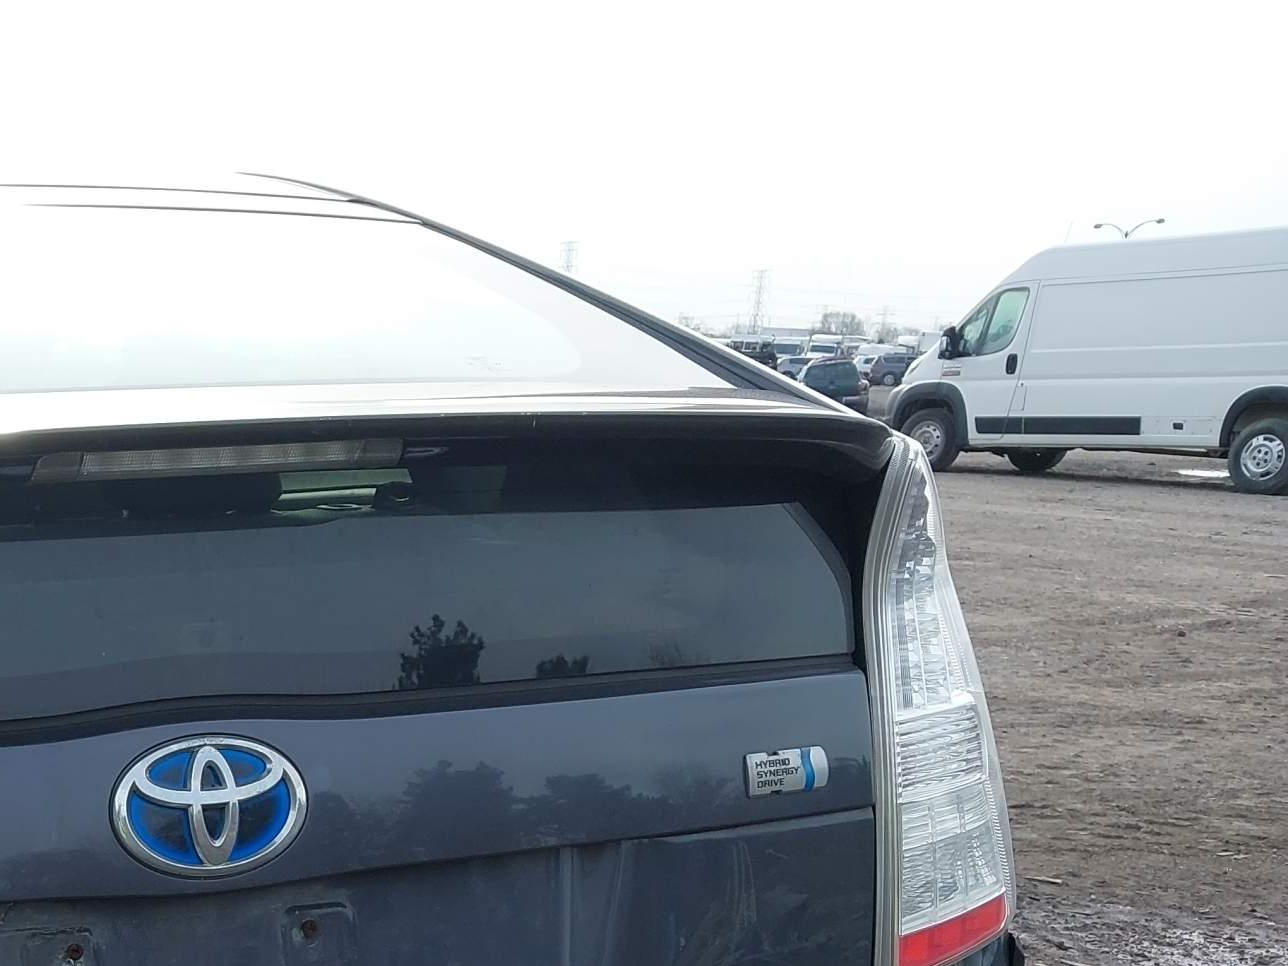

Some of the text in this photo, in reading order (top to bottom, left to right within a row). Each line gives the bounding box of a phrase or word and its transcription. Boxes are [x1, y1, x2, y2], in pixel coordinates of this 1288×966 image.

[754, 758, 791, 769] HYBRID
[756, 766, 800, 779] SYNERGY
[757, 778, 785, 789] DRIVE
